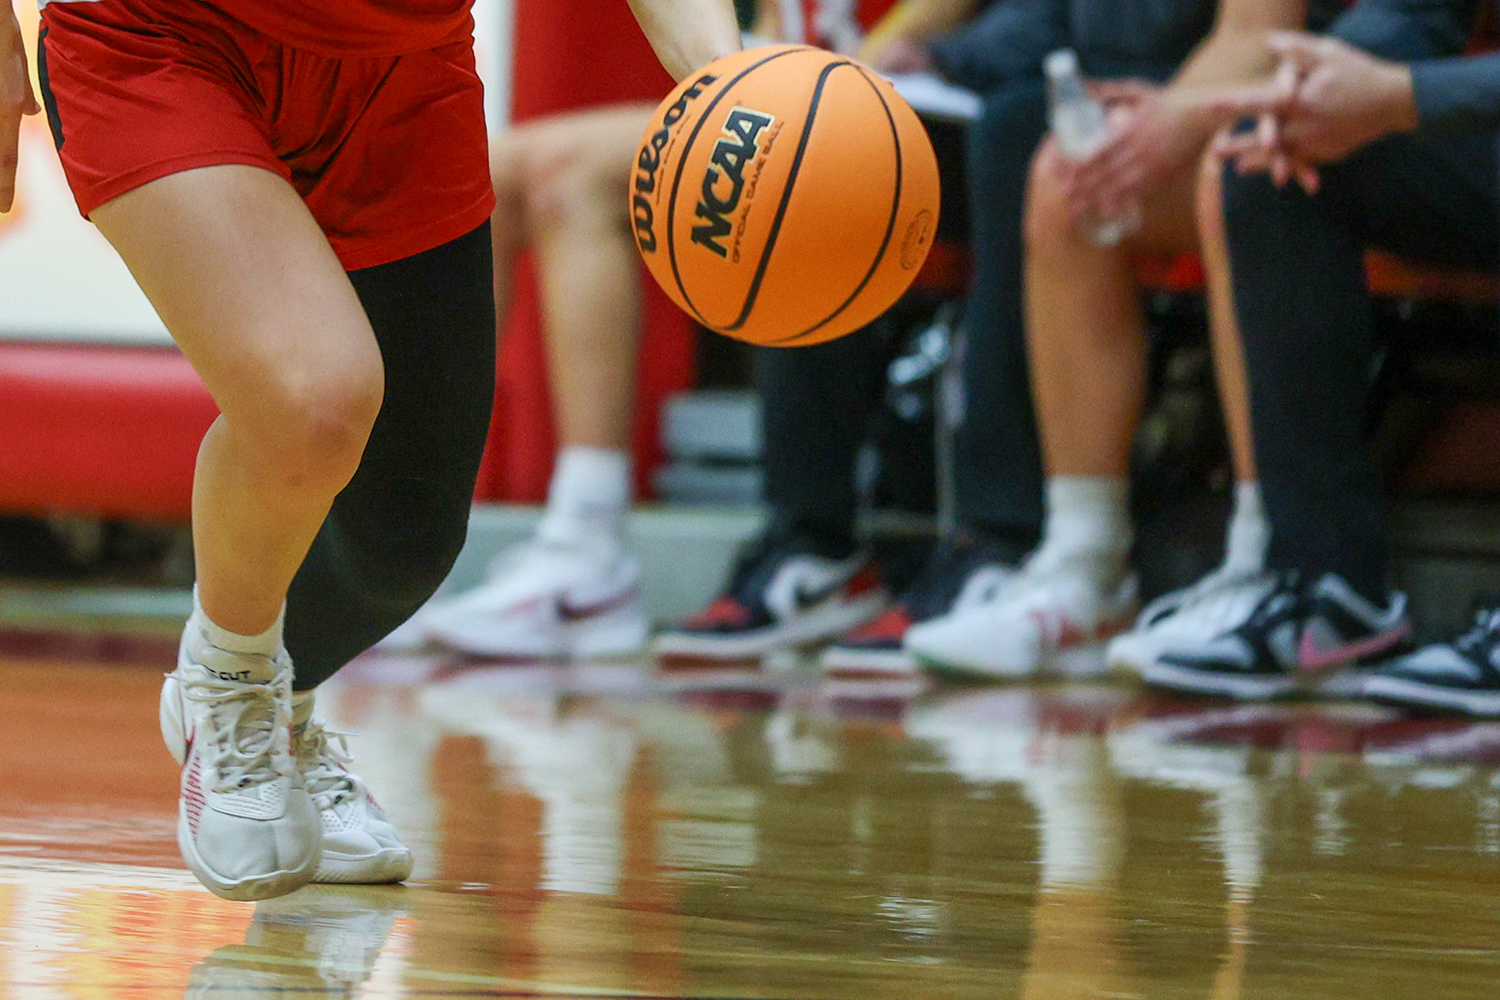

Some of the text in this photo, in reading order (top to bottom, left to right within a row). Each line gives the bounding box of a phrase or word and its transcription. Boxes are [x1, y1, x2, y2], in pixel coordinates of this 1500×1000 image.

[633, 73, 722, 254] Wilson
[690, 106, 775, 258] NCAA
[746, 158, 767, 199] GAME
[762, 121, 785, 155] BALL
